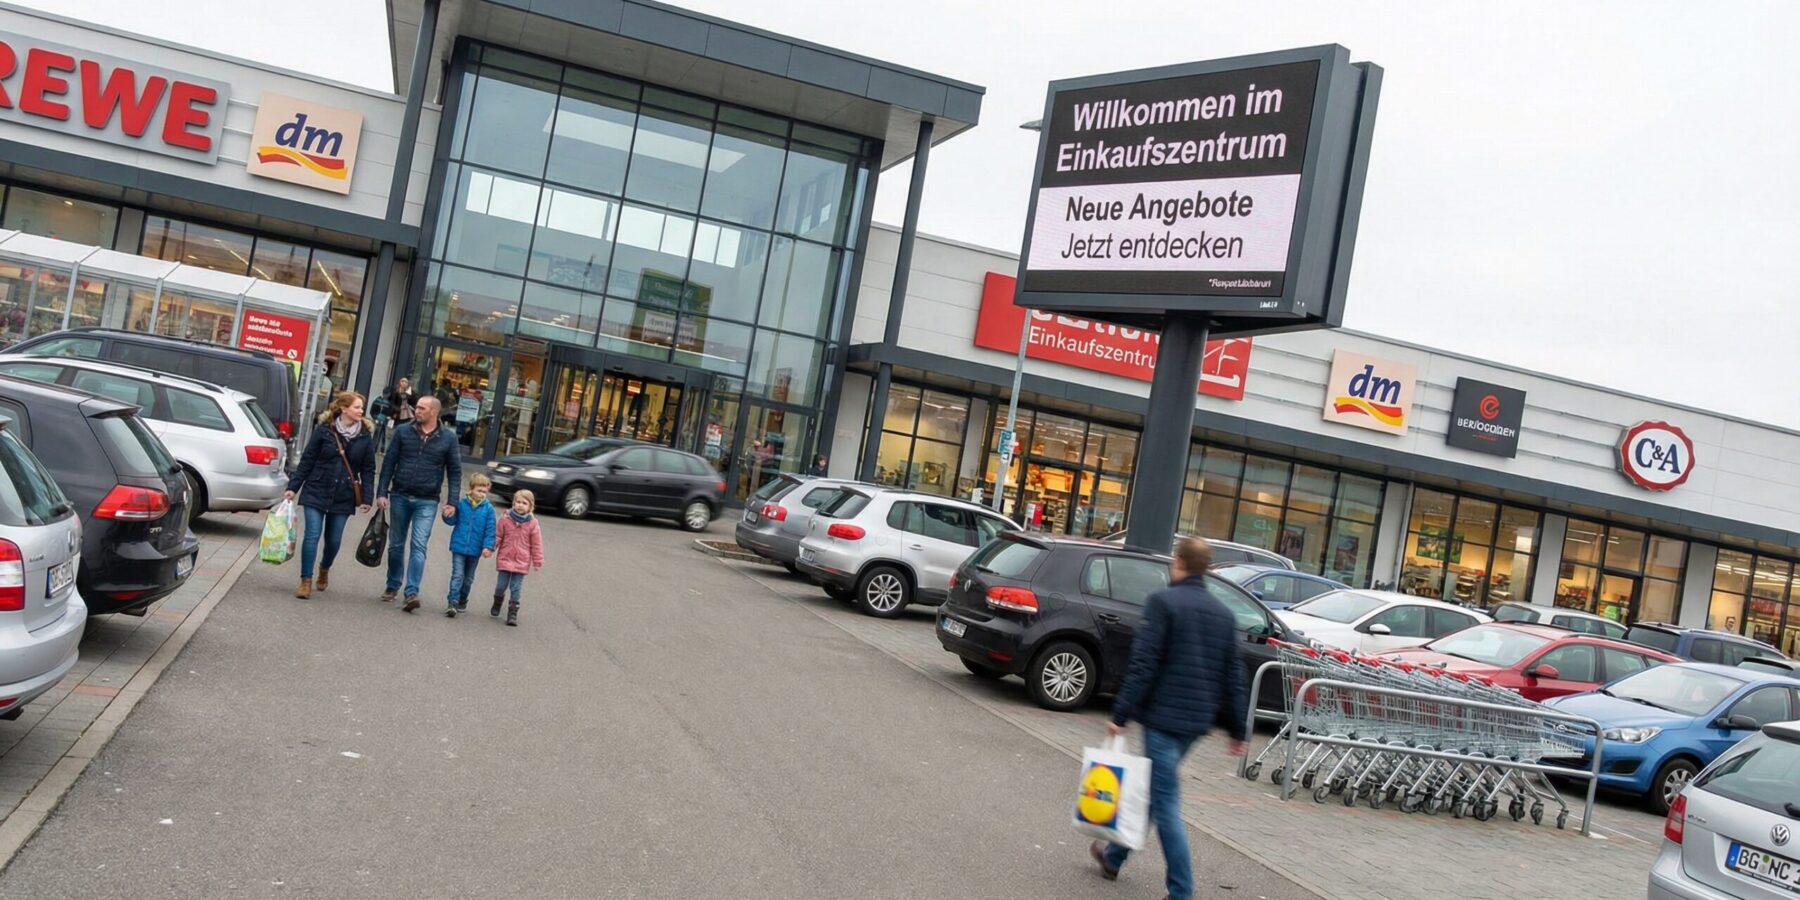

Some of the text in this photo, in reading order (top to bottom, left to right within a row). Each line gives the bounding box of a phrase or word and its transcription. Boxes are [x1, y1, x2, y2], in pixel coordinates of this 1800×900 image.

[1073, 84, 1283, 132] Willkommen im
[275, 112, 344, 157] dm
[1056, 131, 1287, 172] Einkaufszentrum
[1065, 190, 1253, 226] Neue Angebote
[1061, 230, 1244, 259] Jetzt entdecken
[1028, 325, 1155, 369] Einkaufszentru
[1348, 364, 1402, 405] dm
[1634, 438, 1681, 475] C&A
[1738, 849, 1761, 871] BG
[1768, 858, 1791, 881] NC
